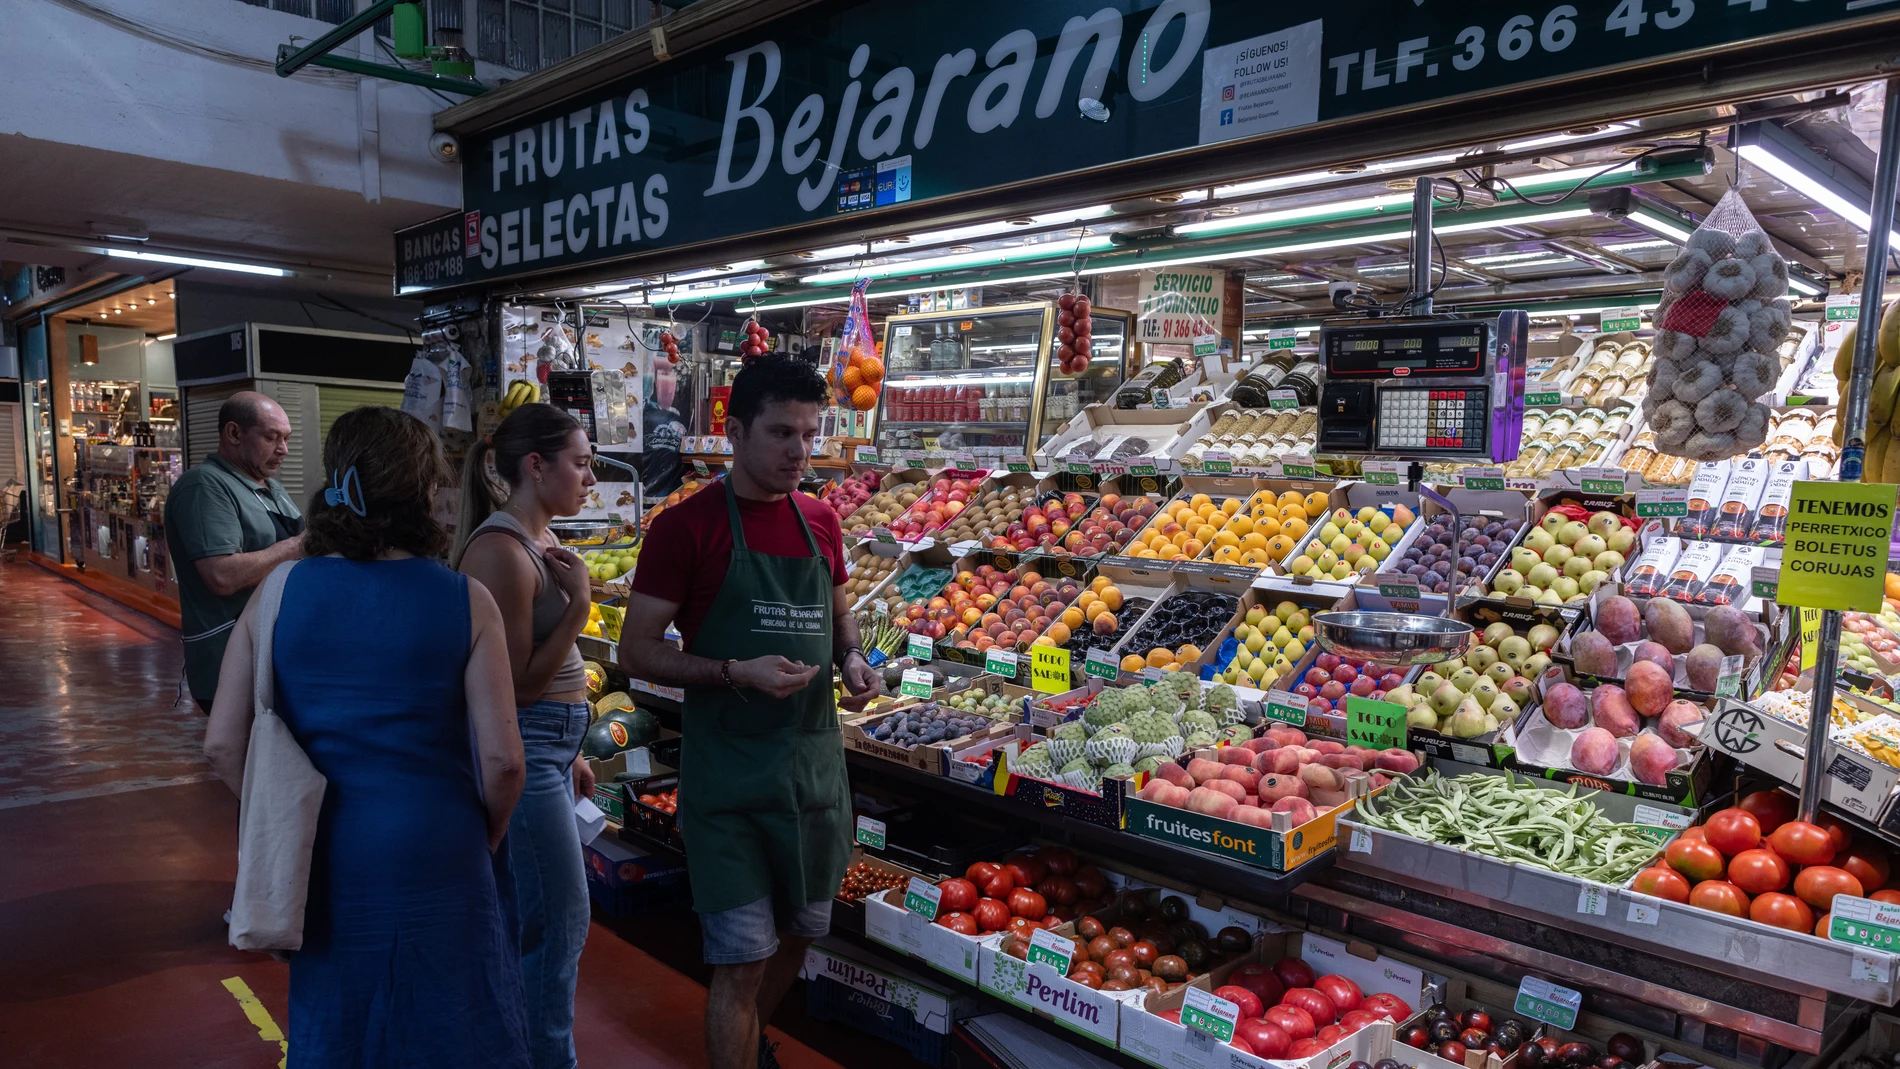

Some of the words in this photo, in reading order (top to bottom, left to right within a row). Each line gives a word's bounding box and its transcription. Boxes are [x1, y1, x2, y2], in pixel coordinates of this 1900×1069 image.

[1236, 40, 1289, 64] ¡SÍGUENOS!
[1328, 35, 1439, 96] TLF.
[1452, 5, 1578, 71] 366
[1233, 61, 1272, 79] FOLLOW
[1273, 57, 1289, 69] US!
[1239, 71, 1287, 88] @FRUTASBEJARANO
[1239, 83, 1293, 100] @BEJARANOGOURMET
[703, 0, 1211, 212] Bejarano
[1238, 104, 1253, 112] Frutas
[1253, 100, 1274, 109] Bejarano
[1237, 115, 1258, 124] Bejarano
[1258, 110, 1279, 119] Gourmet
[492, 88, 651, 192] FRUTAS
[480, 173, 670, 270] SELECTAS
[404, 227, 461, 261] BANCAS
[403, 255, 463, 284] 186-187-188
[1153, 273, 1213, 294] SERVICIO
[1143, 295, 1152, 312] A
[1156, 296, 1220, 316] DOMICILIO
[1163, 319, 1172, 338] 91
[1174, 319, 1190, 338] 366
[1796, 499, 1888, 519] TENEMOS
[1791, 522, 1887, 538] PERRETXICO
[1794, 540, 1877, 557] BOLETUS
[1791, 560, 1875, 578] CORUJAS
[753, 605, 786, 616] FRUTAS
[790, 609, 824, 619] BEJARANO
[1392, 601, 1420, 609] FAMILY
[760, 618, 787, 627] MERCADO
[805, 622, 821, 630] CEBADA
[1037, 653, 1064, 667] TODO
[1356, 711, 1397, 729] TODO
[1146, 814, 1257, 856] fruitesfont
[1316, 948, 1335, 958] Perlim
[826, 957, 889, 998] Perlim
[1391, 973, 1412, 985] Perlim
[1026, 972, 1100, 1026] Perlim
[1549, 992, 1577, 1007] Bejarano
[1210, 1004, 1236, 1019] Bejarano
